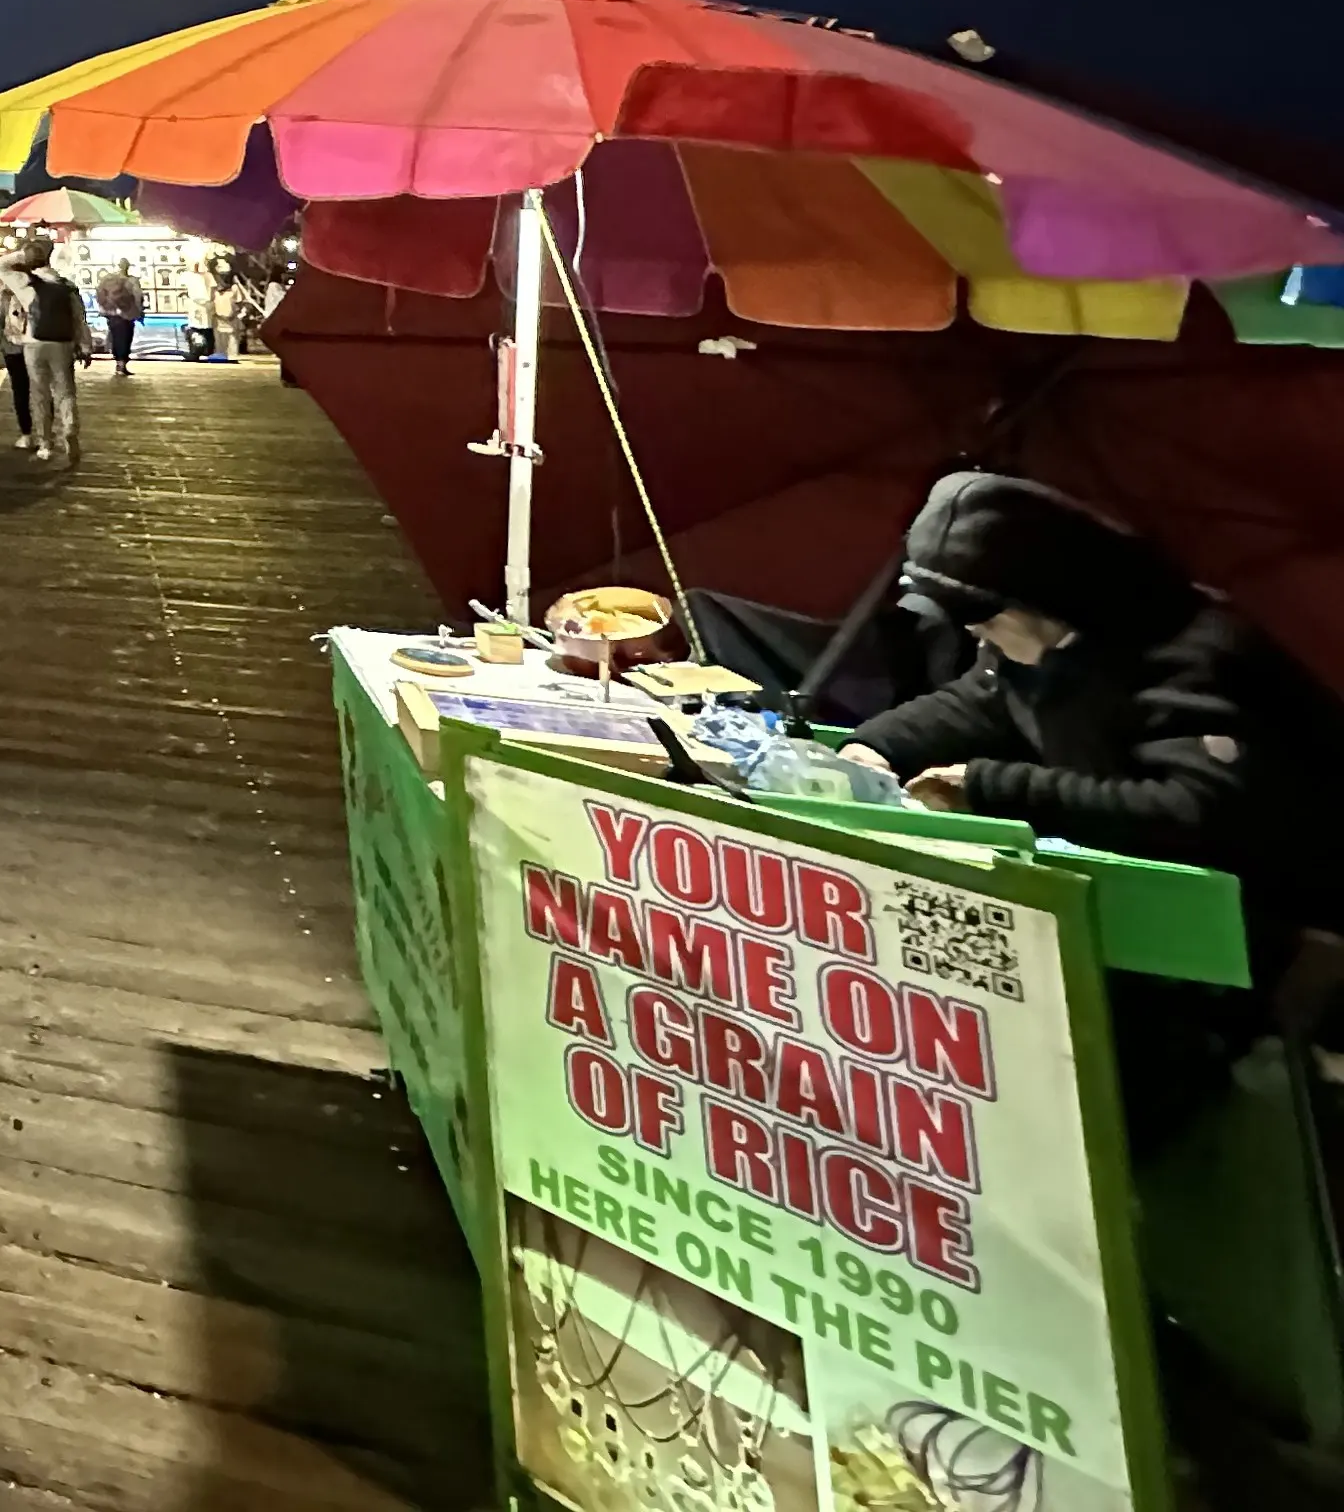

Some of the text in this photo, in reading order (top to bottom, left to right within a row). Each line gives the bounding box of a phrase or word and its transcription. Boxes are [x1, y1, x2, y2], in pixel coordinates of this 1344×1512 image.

[521, 861, 998, 1101] NAME ON
[584, 798, 877, 966] YOUR
[547, 951, 982, 1194] A GRAIN
[564, 1042, 982, 1294] OF RICE
[530, 1158, 1077, 1457] HERE ON THE PIER
[598, 1144, 960, 1336] SINCE 1990
